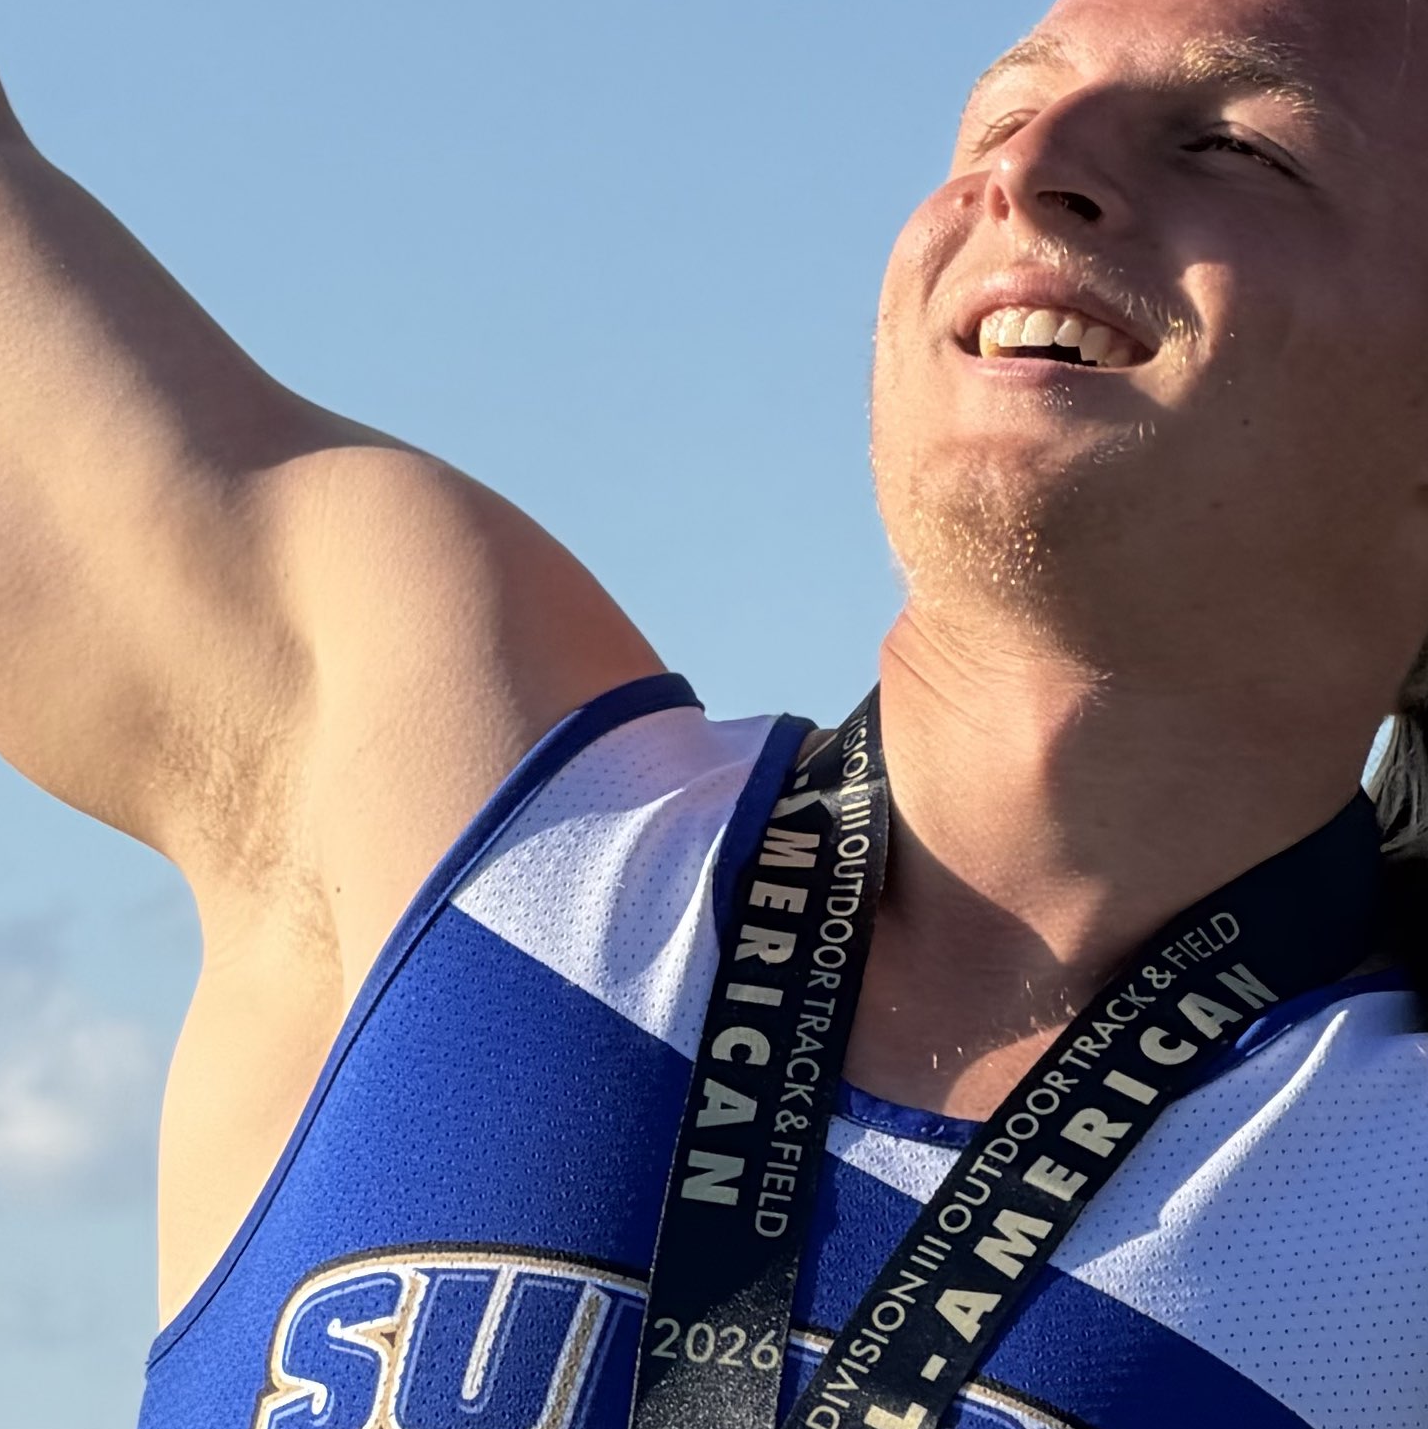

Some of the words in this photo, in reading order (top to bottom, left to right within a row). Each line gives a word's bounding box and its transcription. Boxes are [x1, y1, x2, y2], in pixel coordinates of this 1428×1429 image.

[840, 799, 871, 831] III
[807, 834, 870, 989] OUTDOOR
[780, 997, 836, 1107] TRACK
[909, 1234, 952, 1271] III
[938, 1070, 1080, 1234] OUTDOOR
[1059, 983, 1157, 1070] TRACK
[1142, 965, 1177, 990] &
[1161, 912, 1240, 970] FIELD
[774, 1109, 810, 1133] &
[754, 1141, 803, 1238] FIELD
[650, 1317, 781, 1372] 2026
